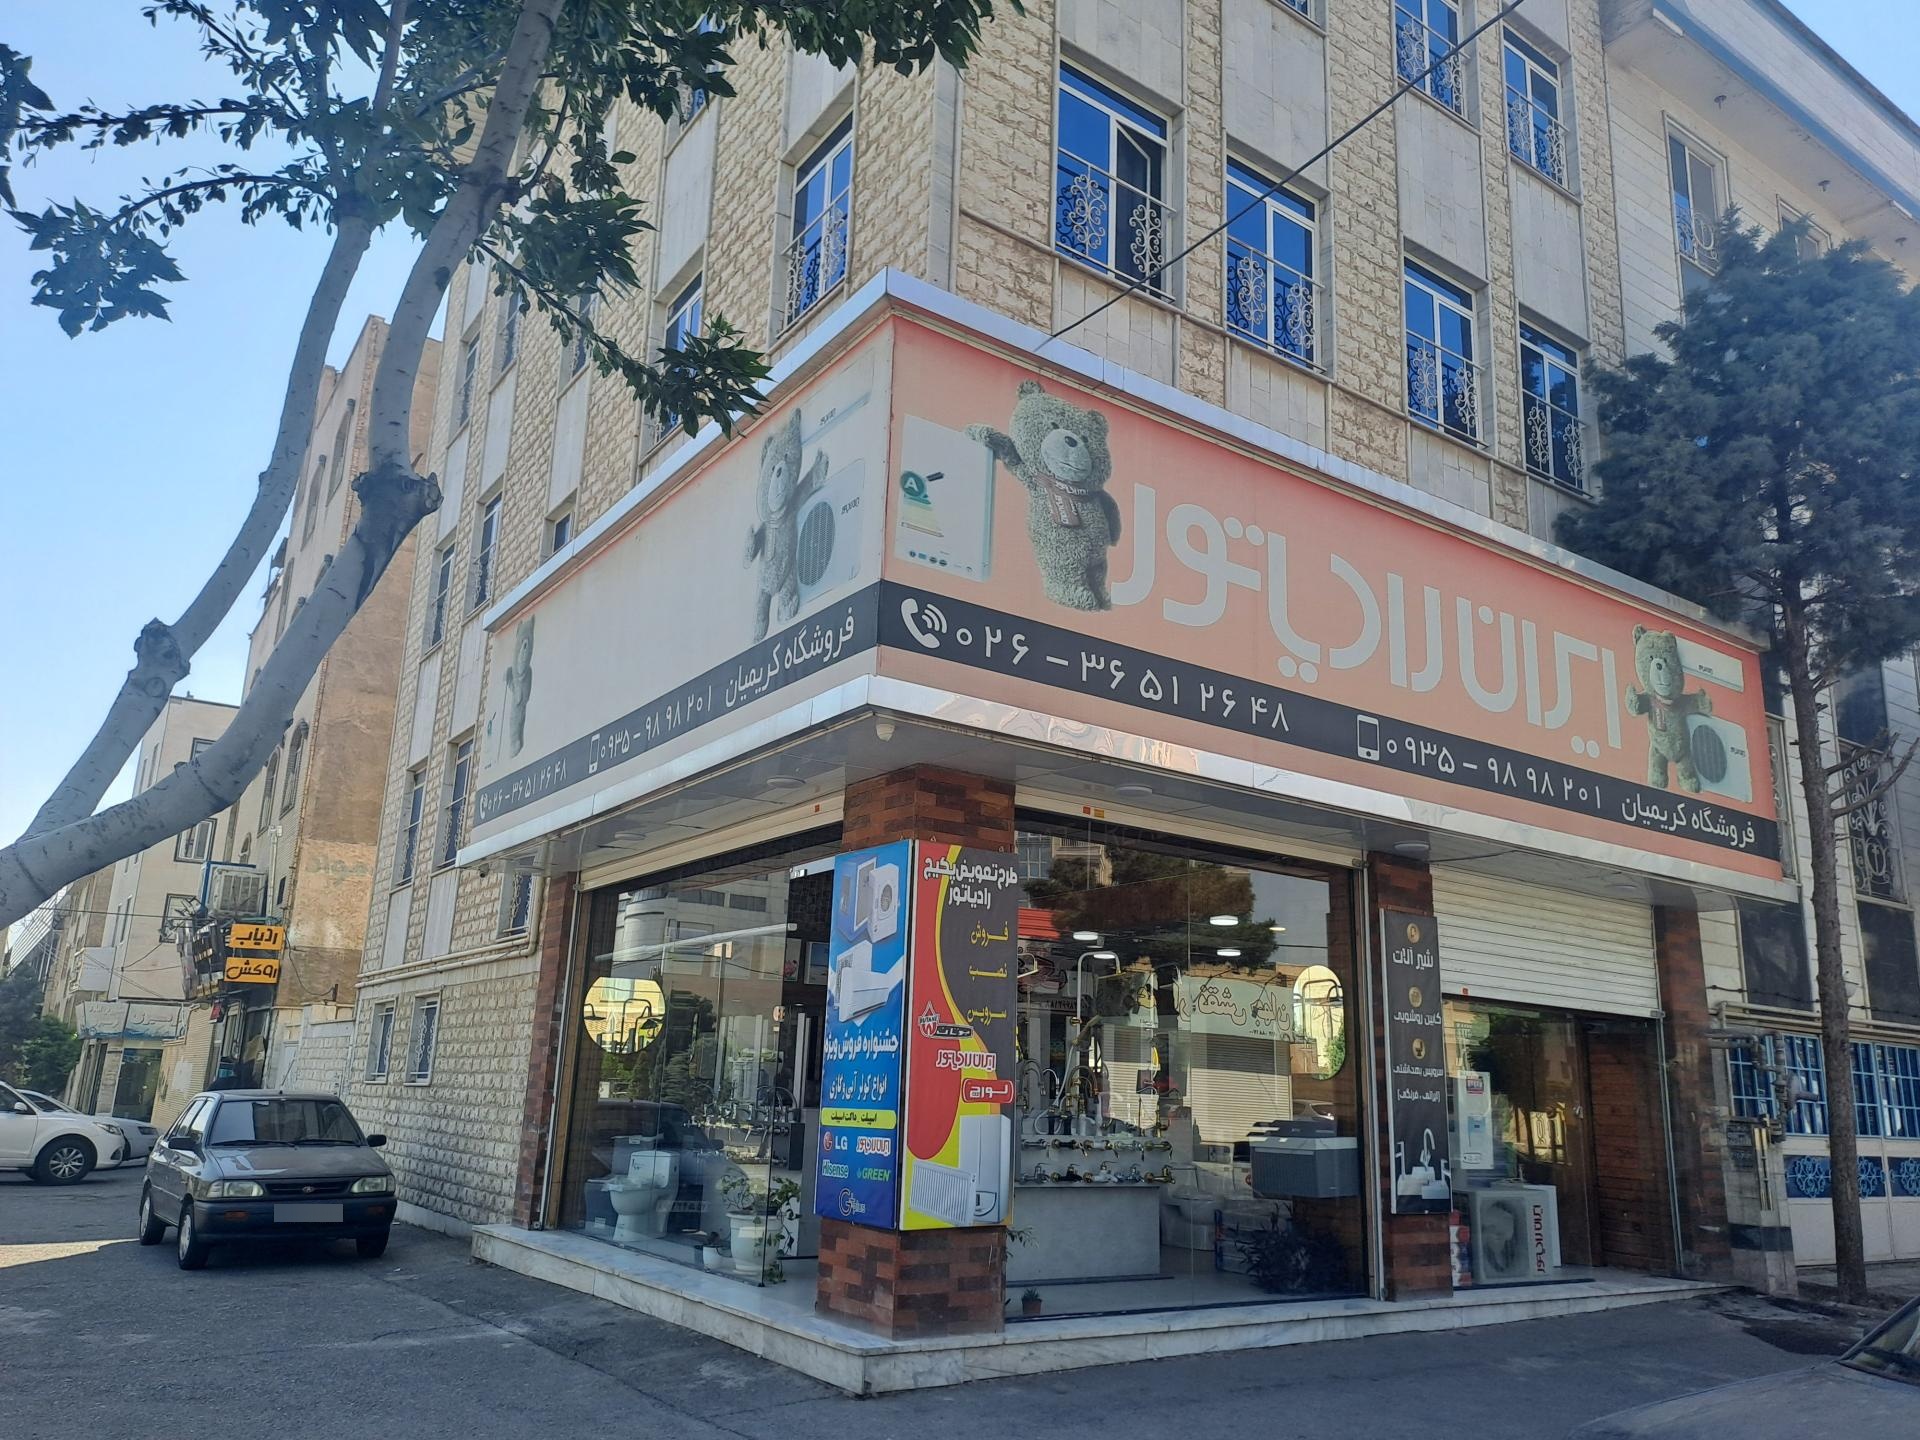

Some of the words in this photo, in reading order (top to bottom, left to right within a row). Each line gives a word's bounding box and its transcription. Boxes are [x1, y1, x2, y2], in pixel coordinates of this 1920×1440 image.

[1111, 483, 1442, 692] رادیاتور
[785, 607, 855, 669] فروشگاه
[725, 642, 781, 707] کریمیان
[1456, 597, 1622, 759] ایران
[1621, 794, 1687, 831] کریمیان
[1691, 806, 1756, 848] فروشگاه
[923, 857, 956, 884] پکیج
[956, 859, 998, 884] تعویض
[997, 866, 1018, 890] طرح
[948, 884, 992, 910] رادیاتور
[236, 928, 278, 945] ردیاب
[970, 920, 1009, 947] فروش
[1392, 946, 1414, 964] آلات
[1415, 949, 1434, 970] شیر
[226, 960, 278, 980] روکش
[969, 963, 1008, 982] نصب
[967, 1006, 1007, 1026] سرویس
[838, 1029, 862, 1060] فروش
[862, 1028, 899, 1060] جشنواره
[936, 1026, 970, 1037] بوتان
[824, 1032, 838, 1060] ویژه
[858, 1073, 871, 1100] کولر
[871, 1073, 887, 1100] انواع
[835, 1135, 848, 1151] LG
[822, 1160, 849, 1179] Hisense
[862, 1167, 891, 1182] GREEN
